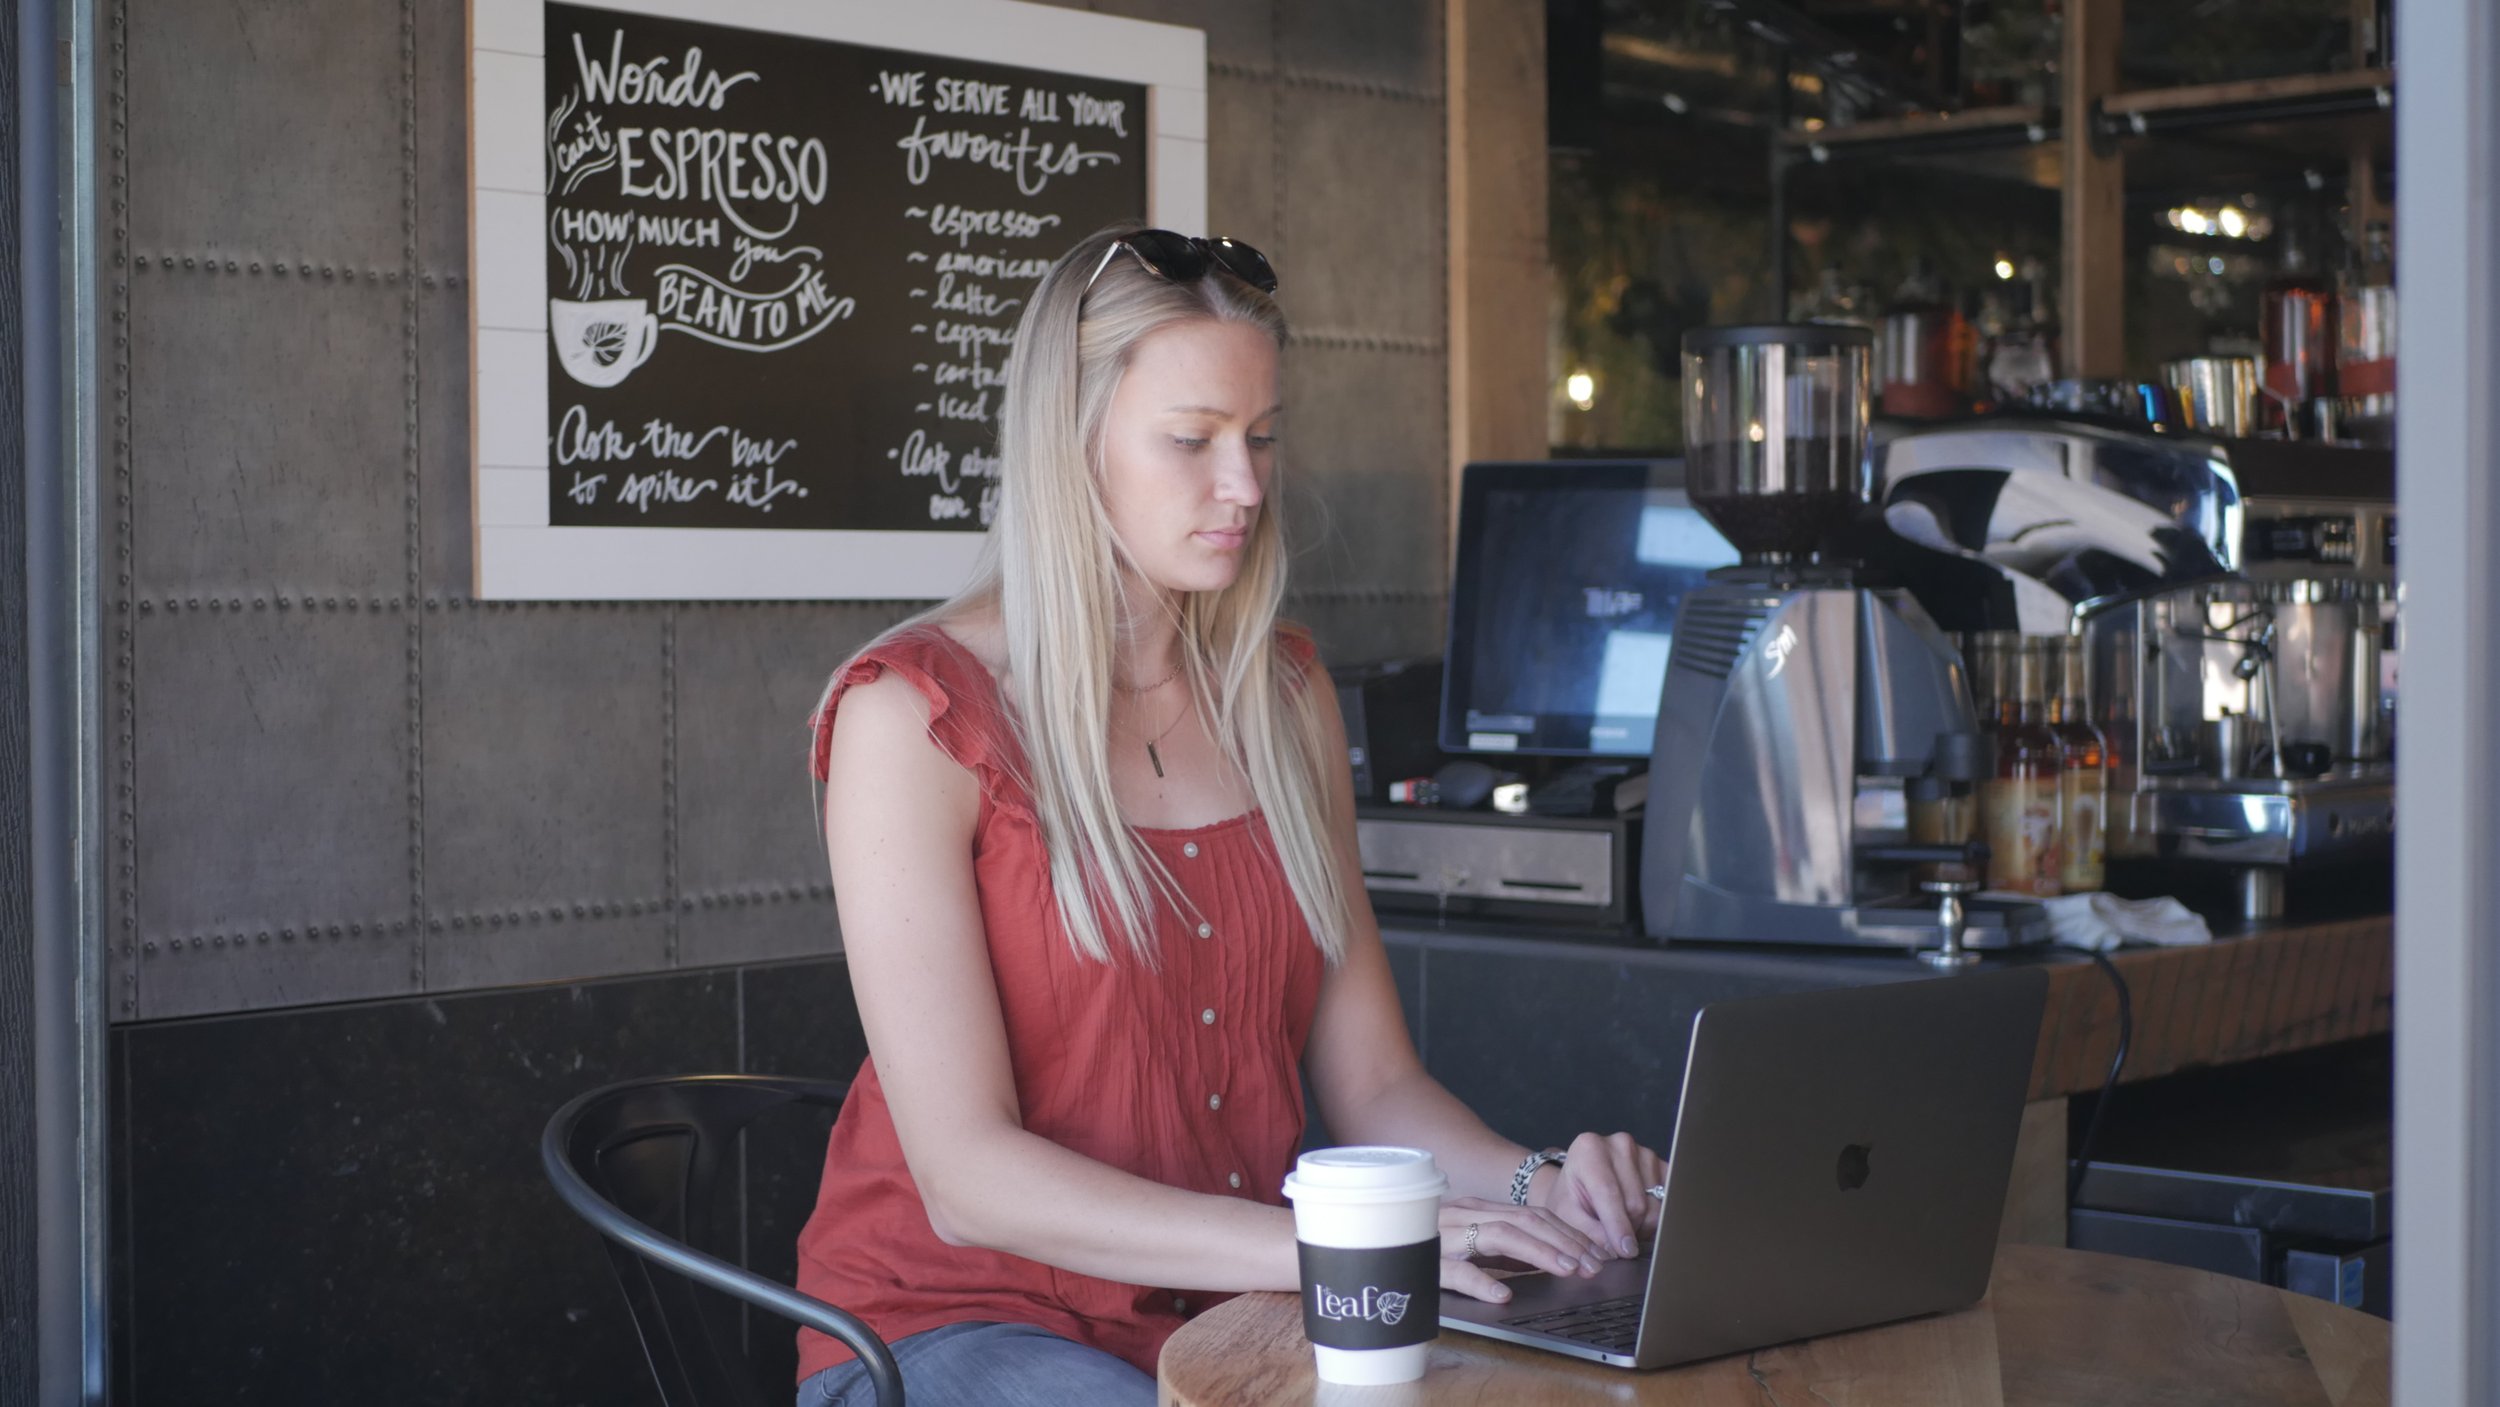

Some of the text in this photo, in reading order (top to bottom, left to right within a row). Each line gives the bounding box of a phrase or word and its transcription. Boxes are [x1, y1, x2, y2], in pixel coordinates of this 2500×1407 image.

[572, 28, 761, 110] Words
[879, 70, 1128, 138] WE SERVE ALL YOUR
[617, 126, 828, 240] ESPRESSO
[562, 208, 823, 283] HOW MUCH you
[929, 203, 1061, 249] espresso
[932, 272, 1022, 316] latte
[935, 248, 1053, 280] american
[657, 269, 837, 340] BEAN TO ME
[557, 404, 798, 468] Ask the bar
[900, 429, 960, 494] Ask
[569, 471, 607, 505] to
[616, 469, 718, 514] spike
[1315, 1283, 1379, 1321] Leaf
